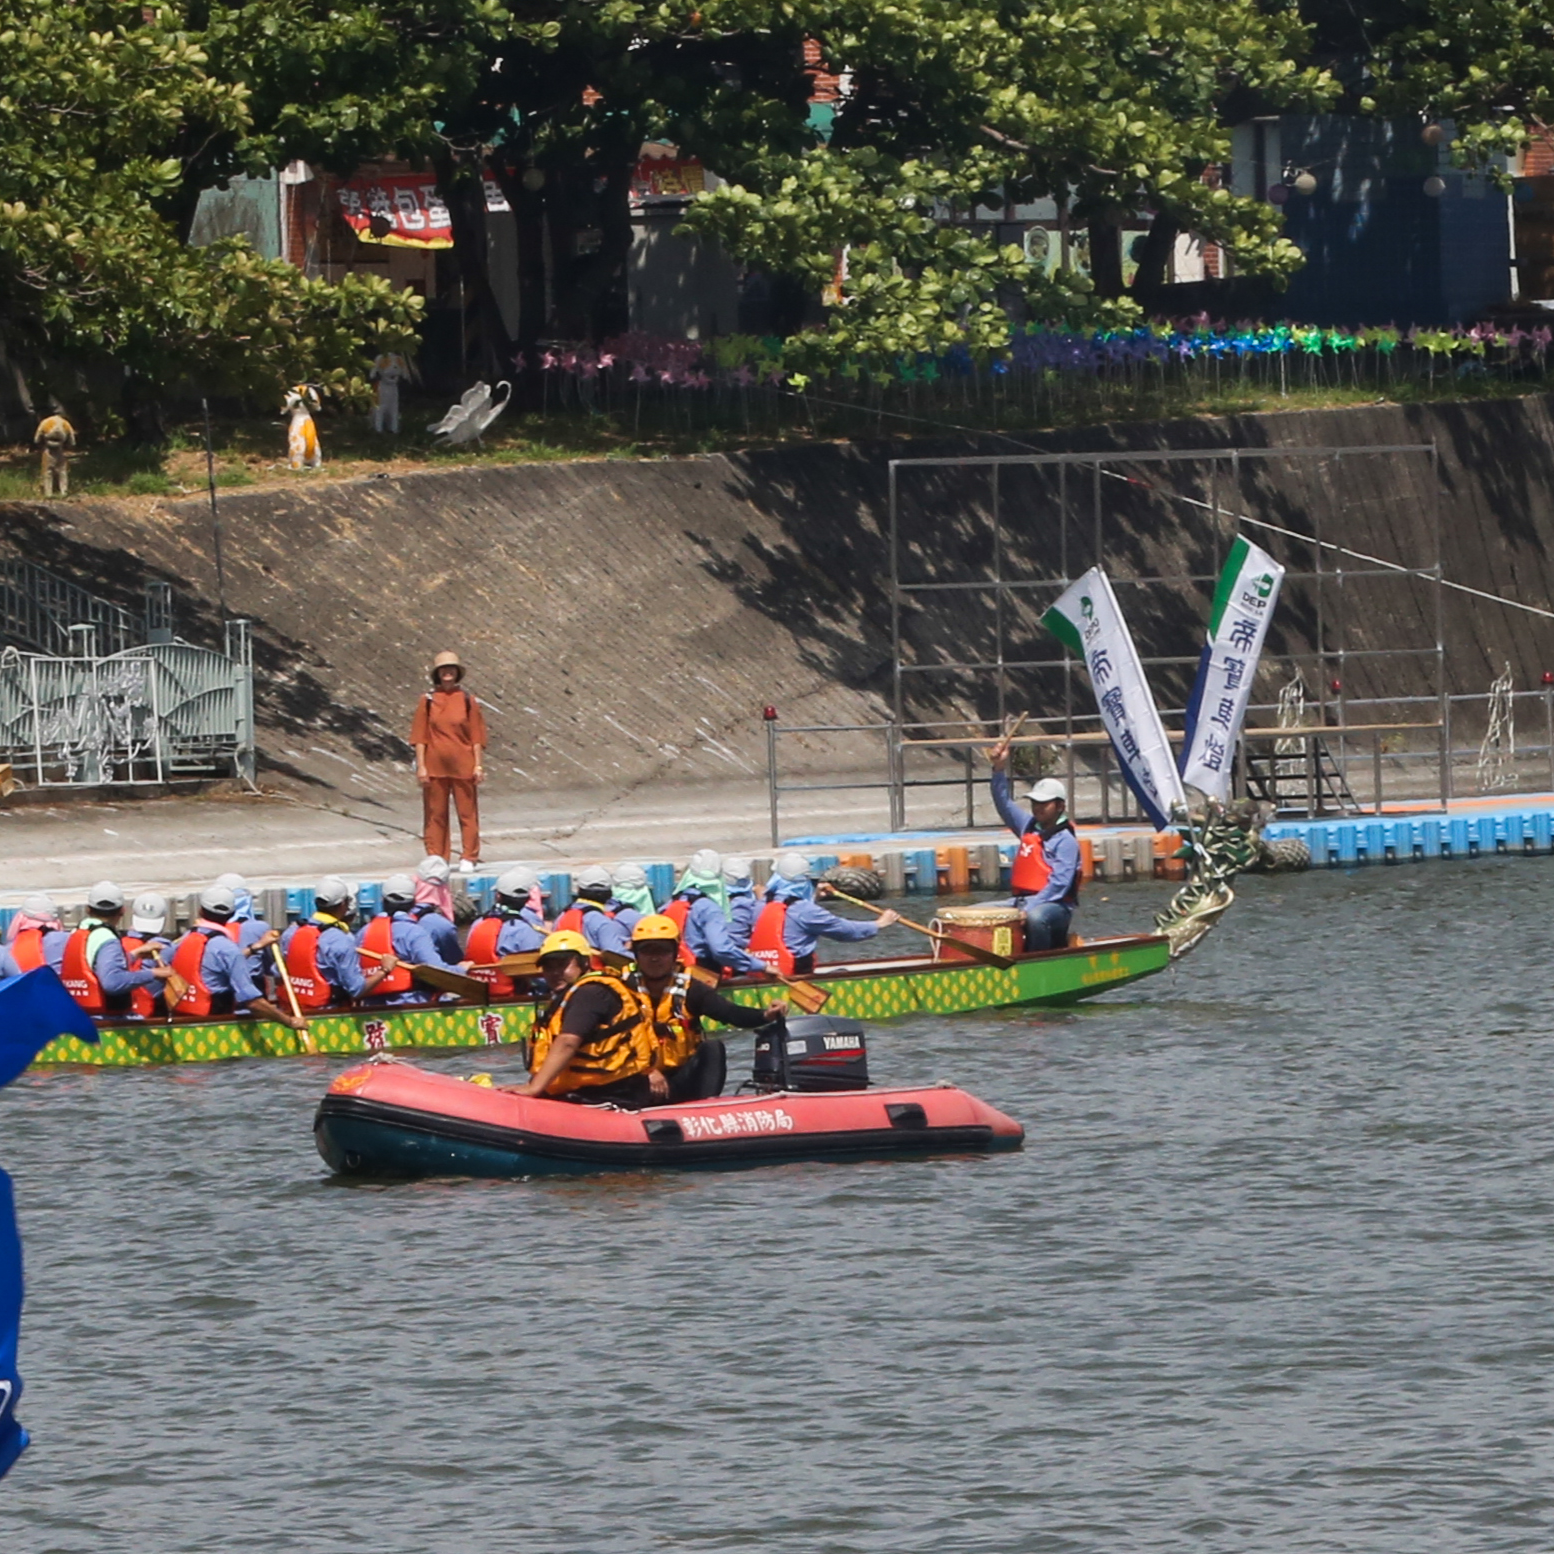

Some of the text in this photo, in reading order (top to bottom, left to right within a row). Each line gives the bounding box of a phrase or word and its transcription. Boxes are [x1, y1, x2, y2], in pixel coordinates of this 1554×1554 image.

[822, 1035, 861, 1050] YAMAHA
[683, 1107, 794, 1138] 彰化縣消防局
